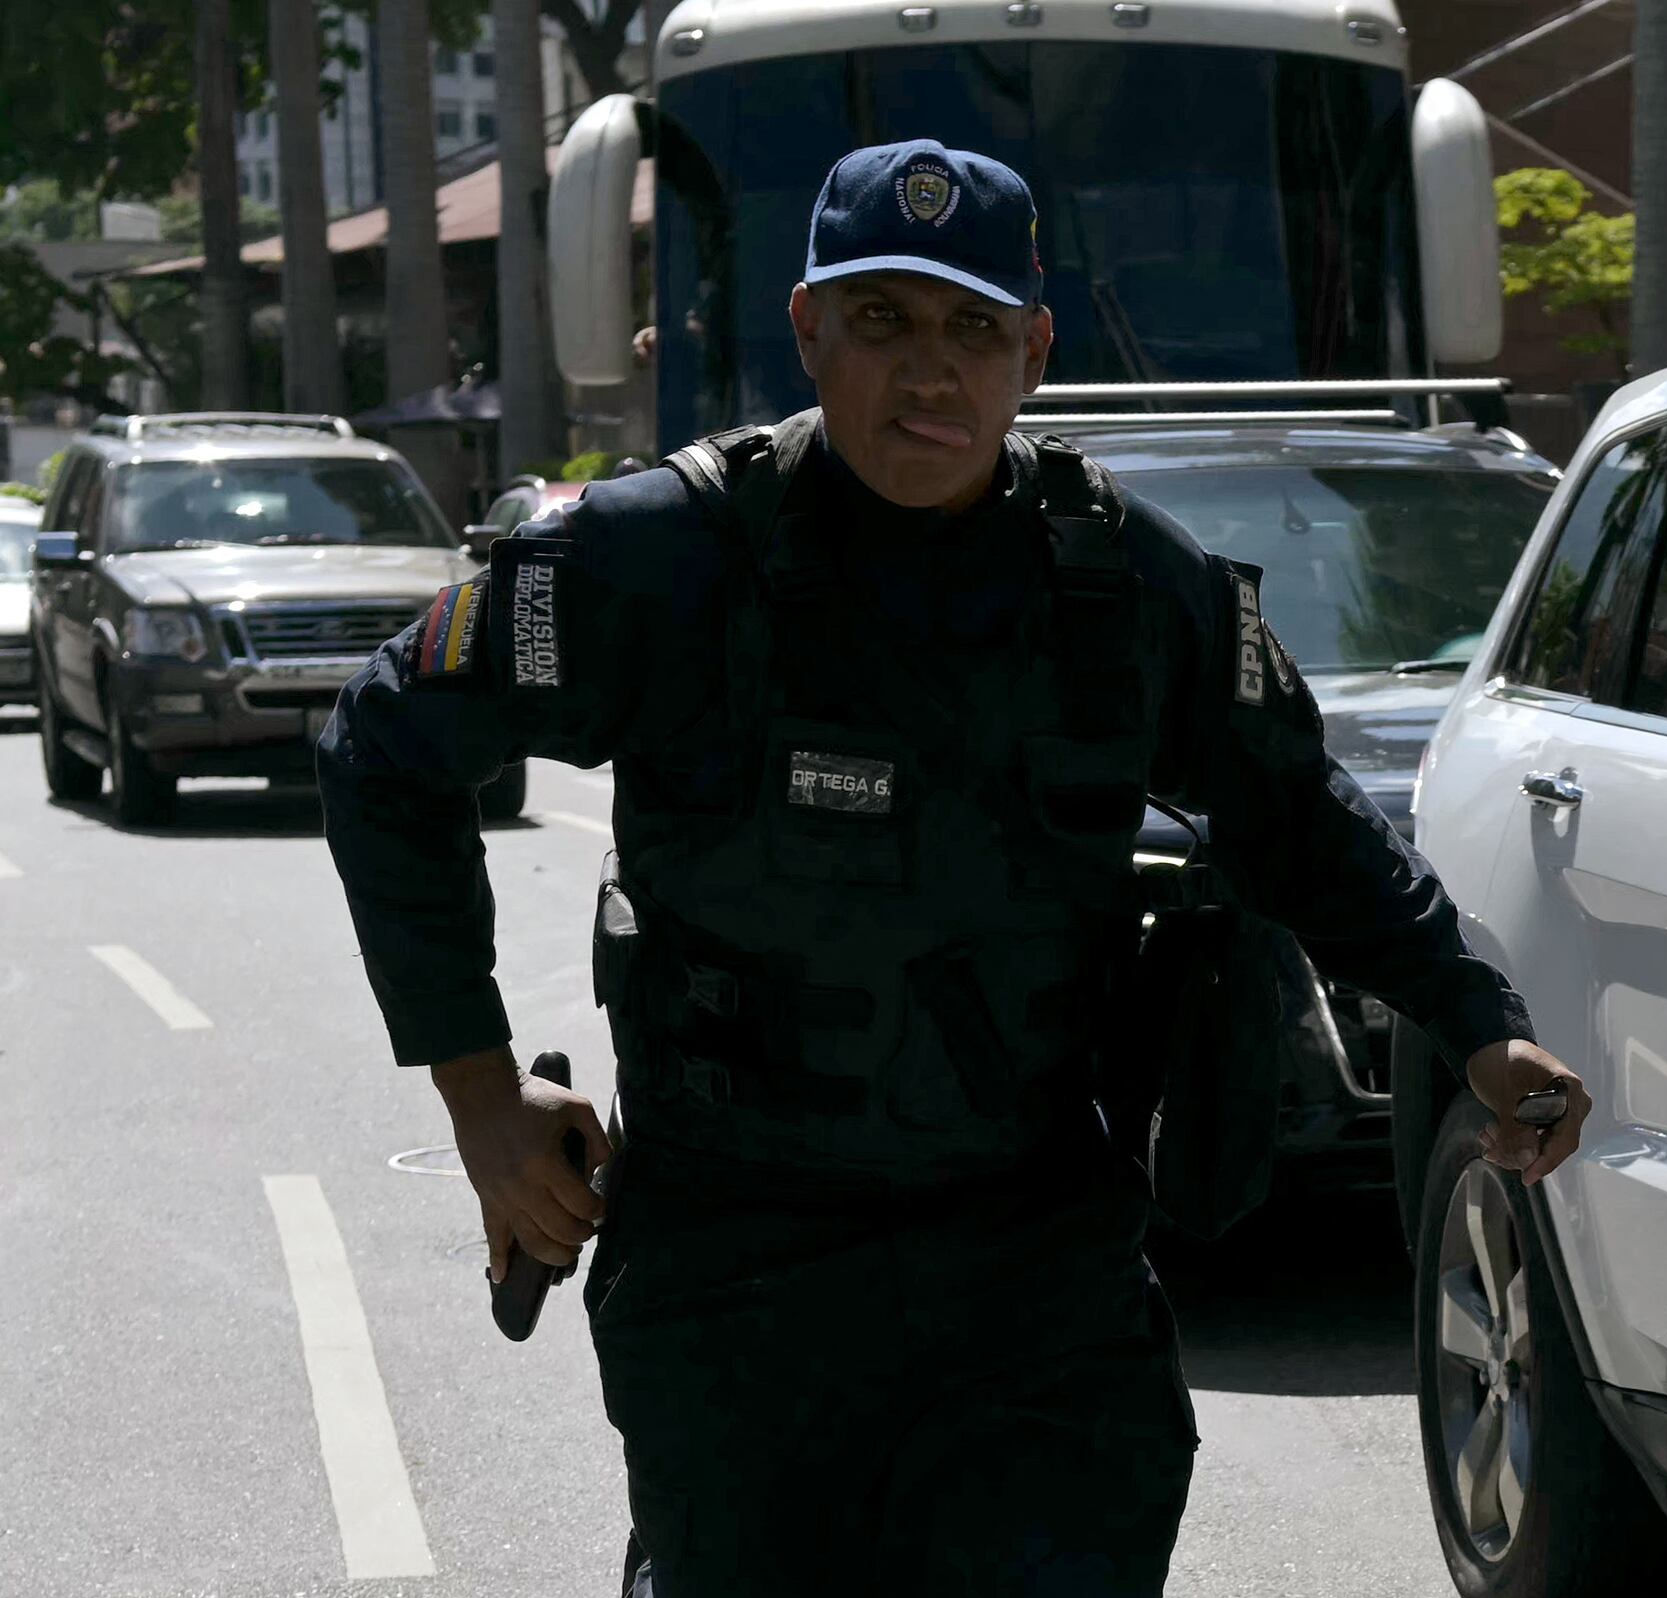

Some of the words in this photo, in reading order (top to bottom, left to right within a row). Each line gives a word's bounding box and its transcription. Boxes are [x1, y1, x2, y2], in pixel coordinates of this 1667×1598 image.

[456, 584, 482, 665] VENEZUELA
[1238, 581, 1263, 700] CPNB
[791, 770, 868, 793] ORTEGA
[874, 779, 892, 796] G.
